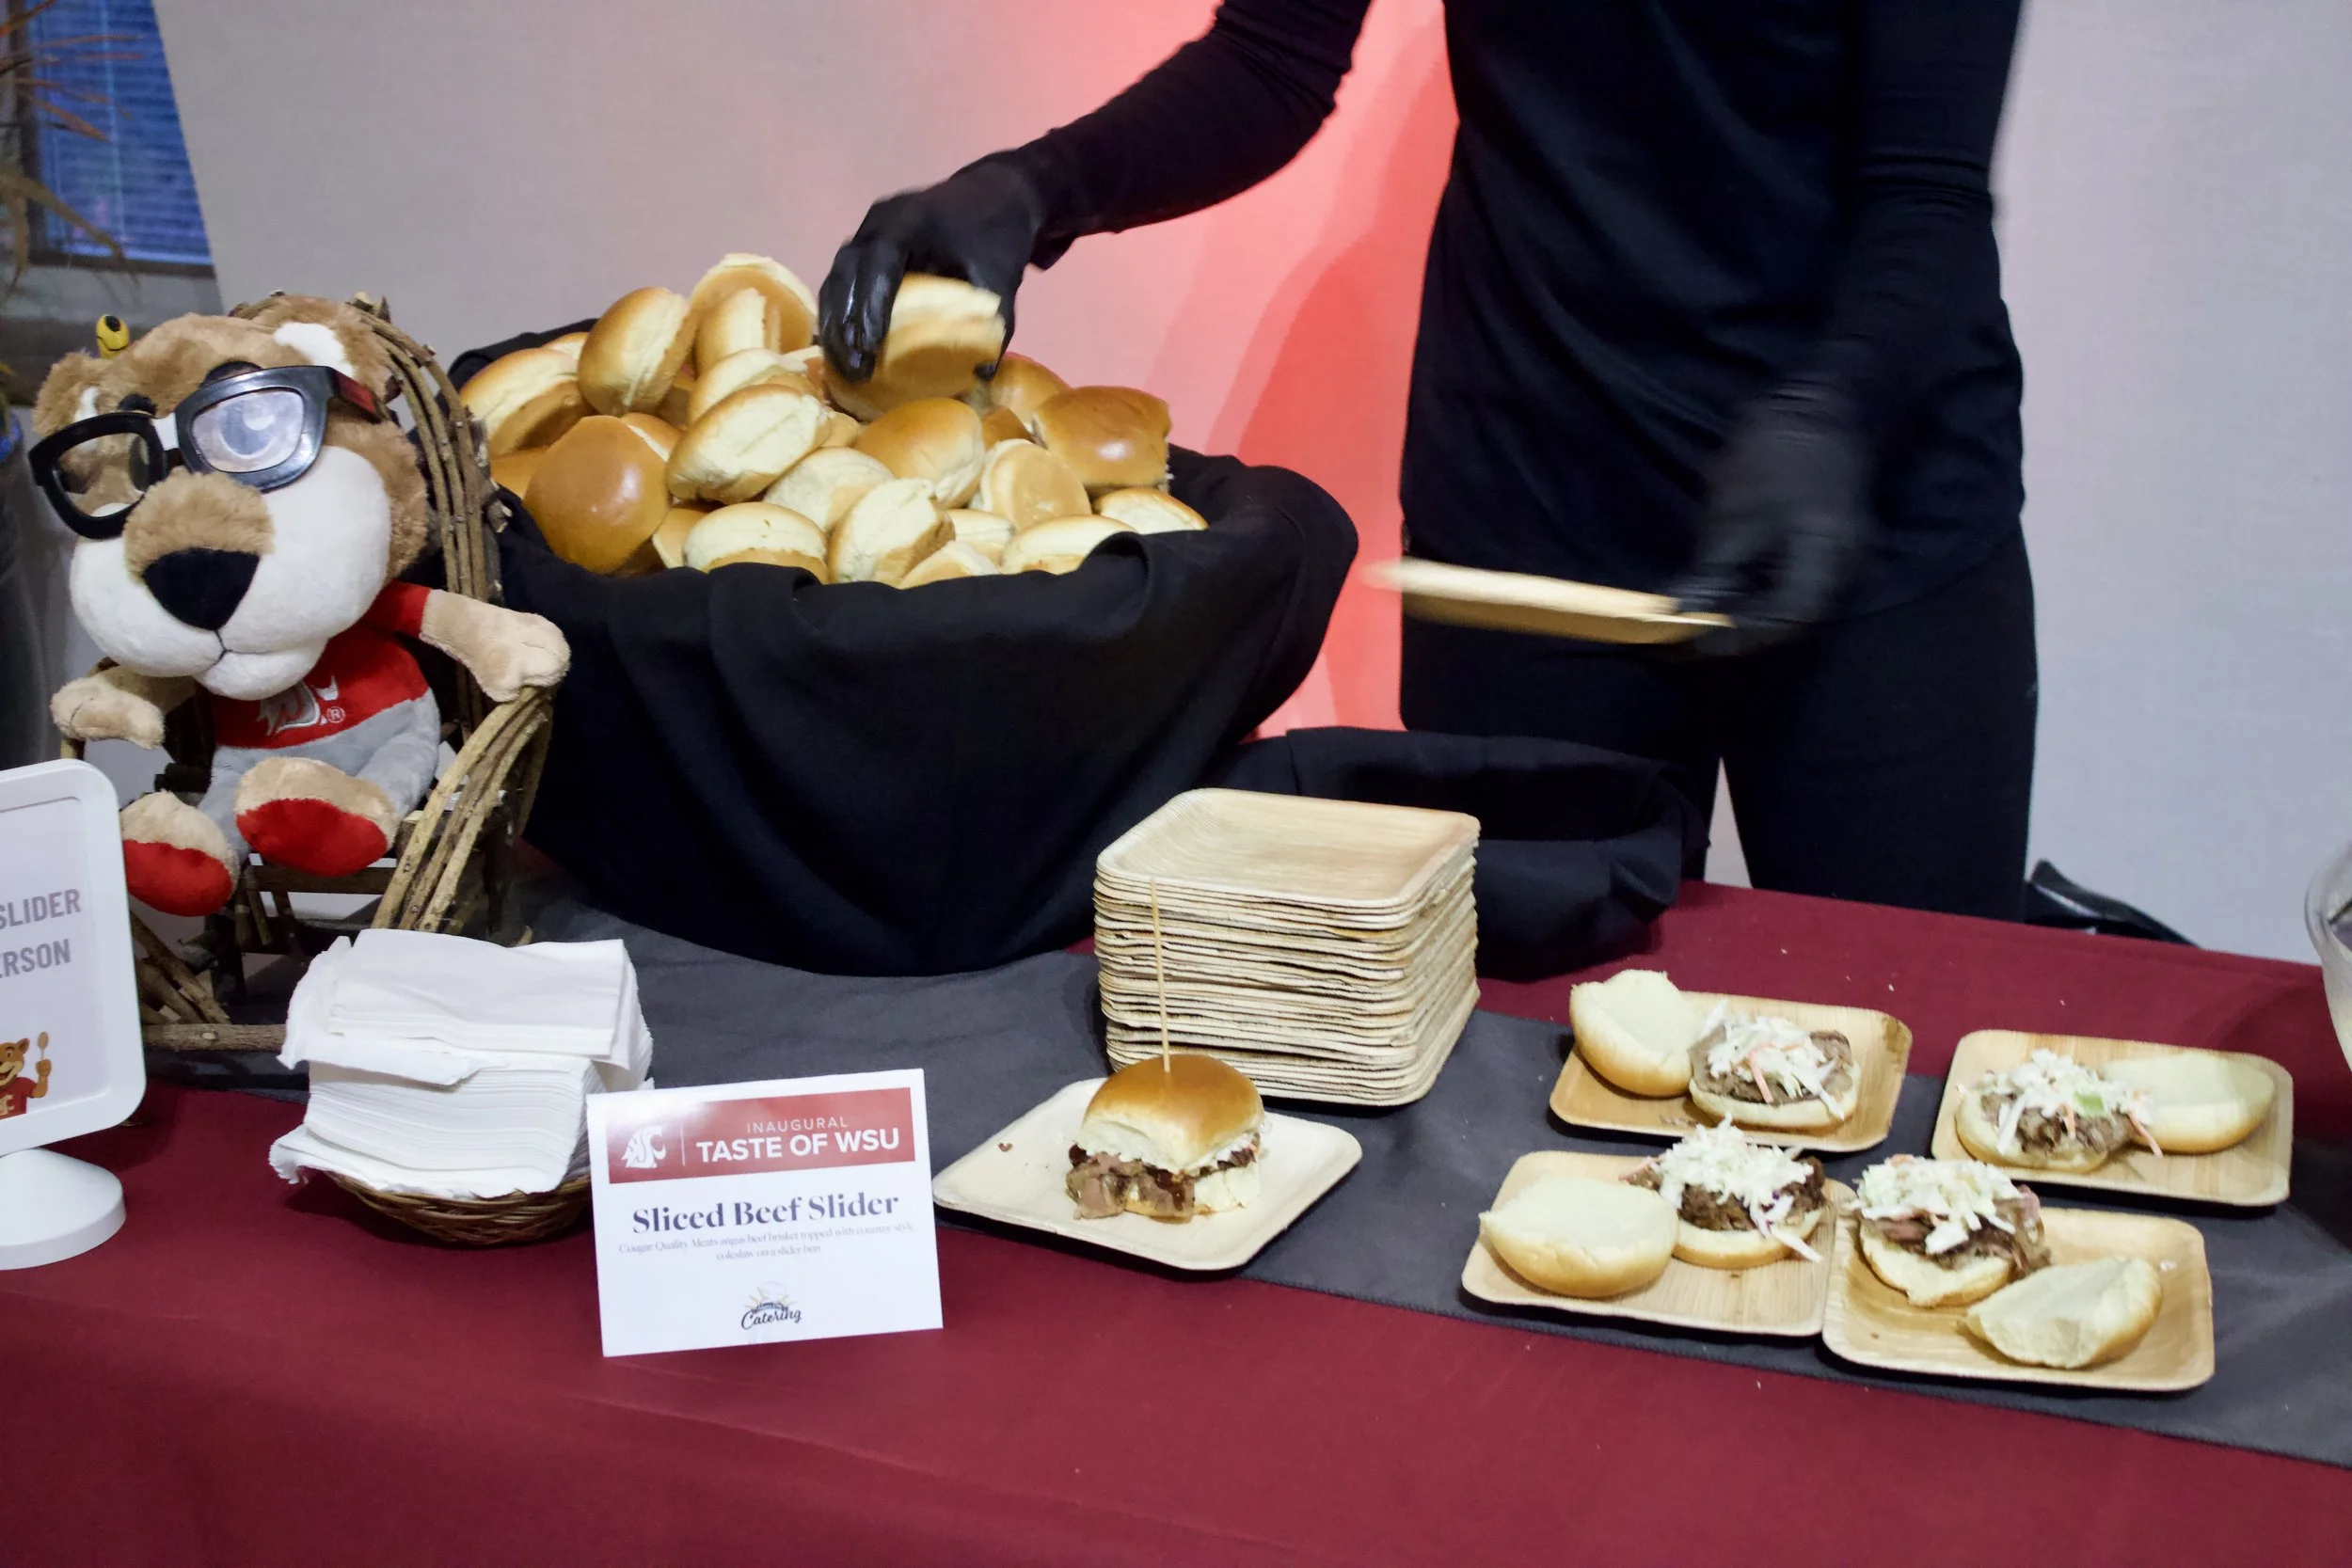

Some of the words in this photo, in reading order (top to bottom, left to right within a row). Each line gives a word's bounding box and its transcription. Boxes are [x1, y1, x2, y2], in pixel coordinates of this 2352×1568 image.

[0, 939, 72, 977] RSON
[746, 1116, 849, 1134] INAUGURAL
[696, 1136, 783, 1163] TASTE
[789, 1132, 828, 1156] OF
[834, 1127, 900, 1153] WSU
[632, 1201, 725, 1234] Sliced
[734, 1196, 803, 1226] Beef
[808, 1191, 899, 1221] Slider
[618, 1242, 654, 1255] Cougar
[655, 1239, 688, 1253] Quality
[691, 1237, 719, 1248] Meats
[720, 1235, 746, 1248] angus
[747, 1233, 767, 1243] beef
[768, 1230, 799, 1243] brisket
[801, 1227, 834, 1242] topped
[834, 1226, 855, 1237] with
[715, 1248, 755, 1261] coleslaw
[756, 1248, 770, 1257] on
[771, 1248, 777, 1257] a
[777, 1244, 802, 1257] slider
[803, 1243, 821, 1254] bun
[741, 1308, 802, 1330] Catering
